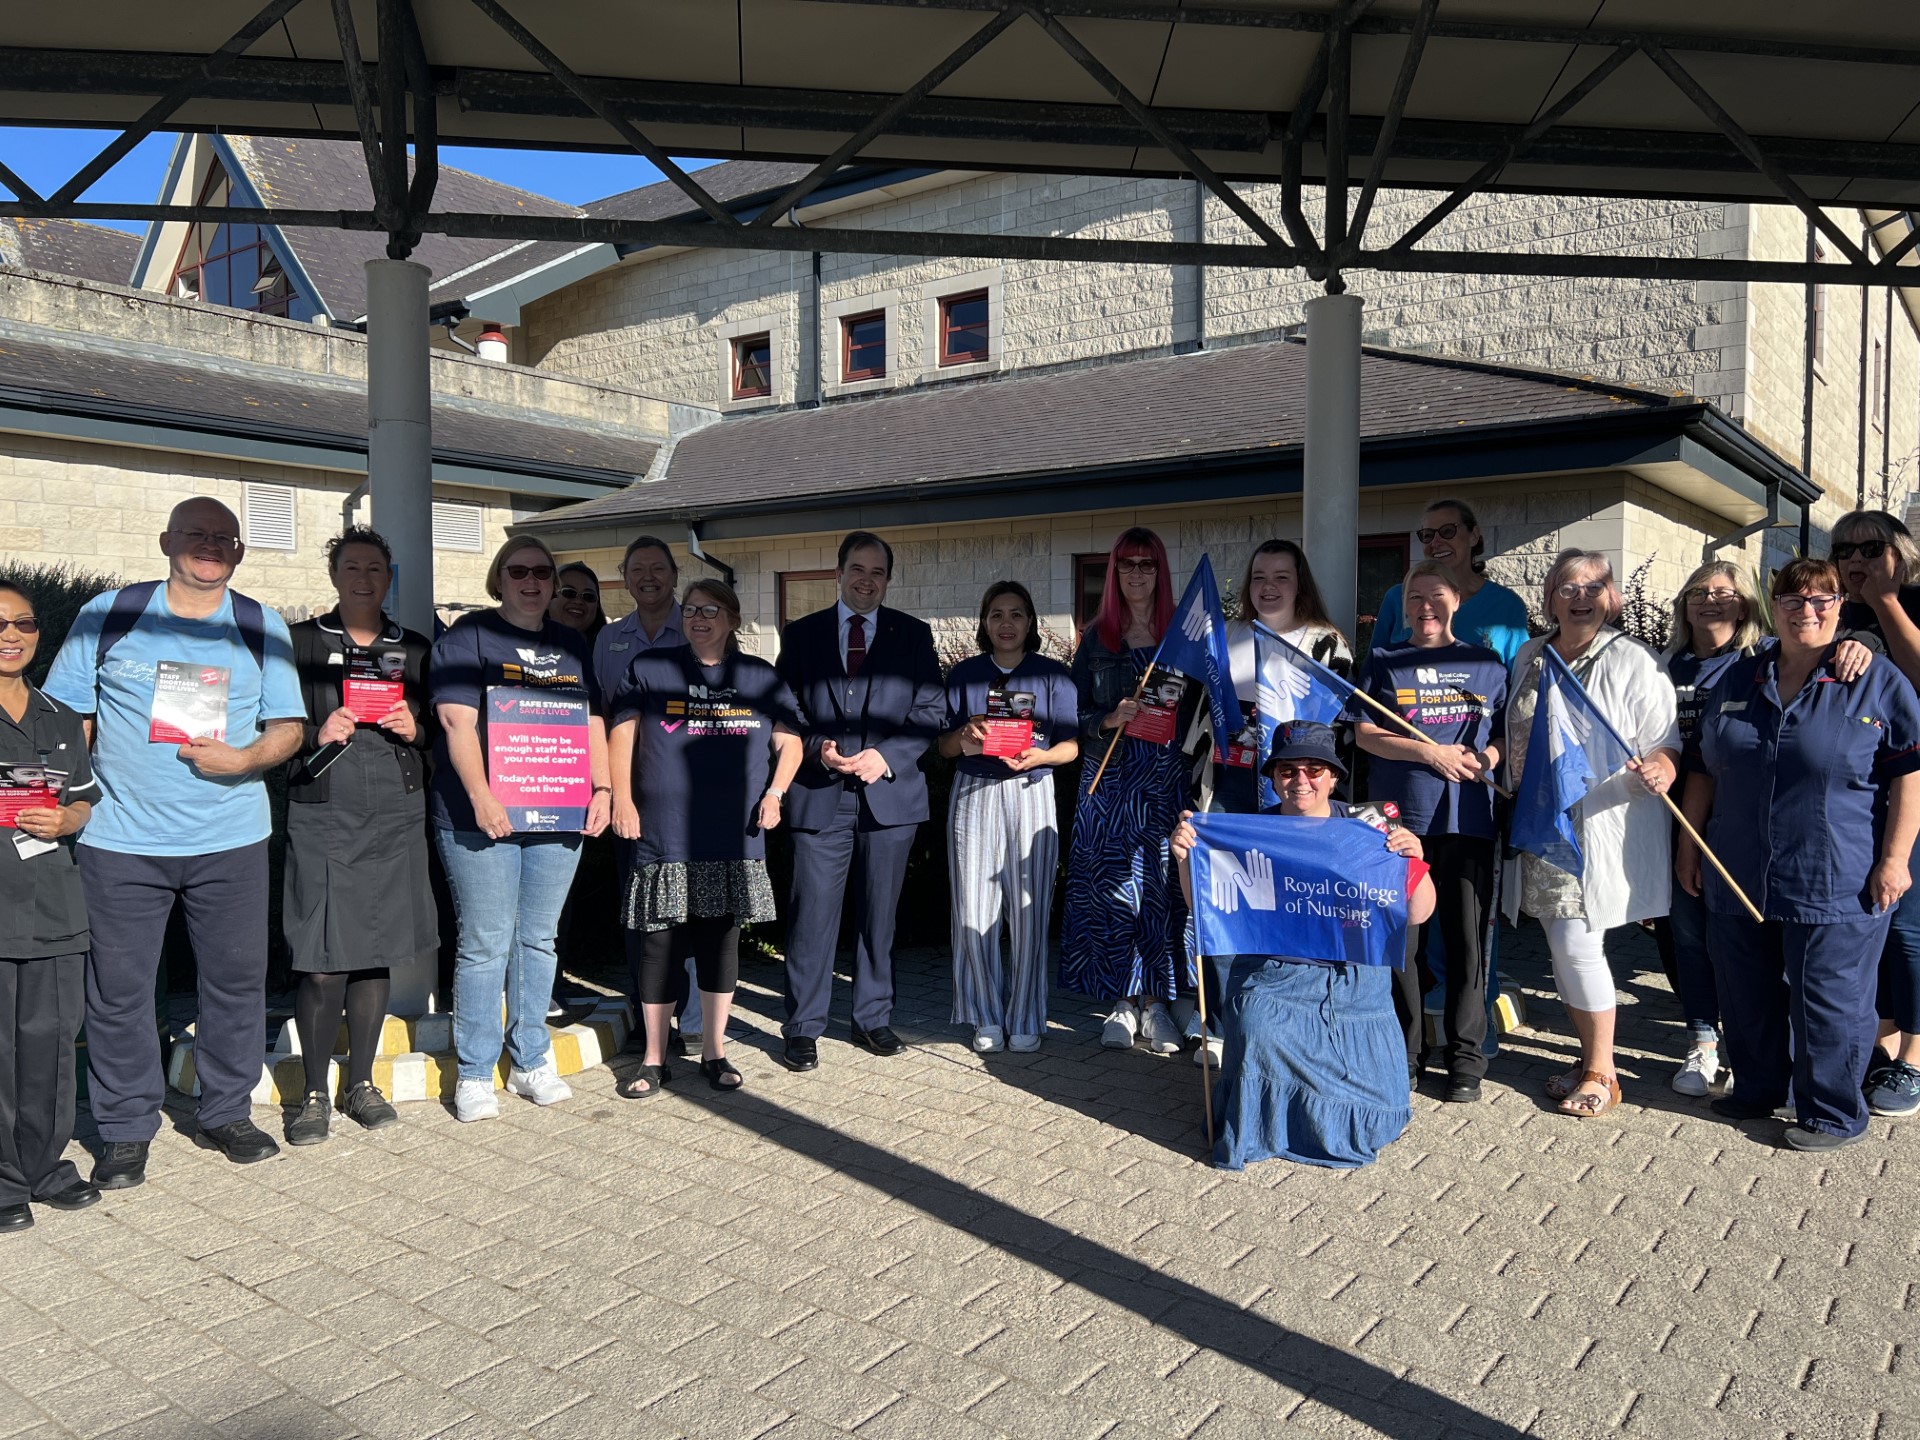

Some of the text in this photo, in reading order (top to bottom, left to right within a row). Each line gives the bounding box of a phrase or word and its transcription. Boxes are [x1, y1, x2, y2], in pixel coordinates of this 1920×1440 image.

[538, 668, 557, 678] PAY
[538, 675, 578, 686] NURSING
[1444, 694, 1487, 703] NURSING
[543, 700, 582, 709] STAFFING
[1421, 705, 1490, 717] SAFE STAFFING
[1679, 710, 1696, 718] AIR
[1422, 714, 1478, 724] SAVES LIVES
[509, 735, 571, 744] Will there be
[494, 746, 586, 755] enough staff when
[504, 755, 577, 765] you need care?
[497, 774, 585, 785] Today's shortages
[520, 785, 565, 793] cost lives
[1284, 876, 1398, 908] Royal College
[1285, 898, 1372, 928] of Nursing
